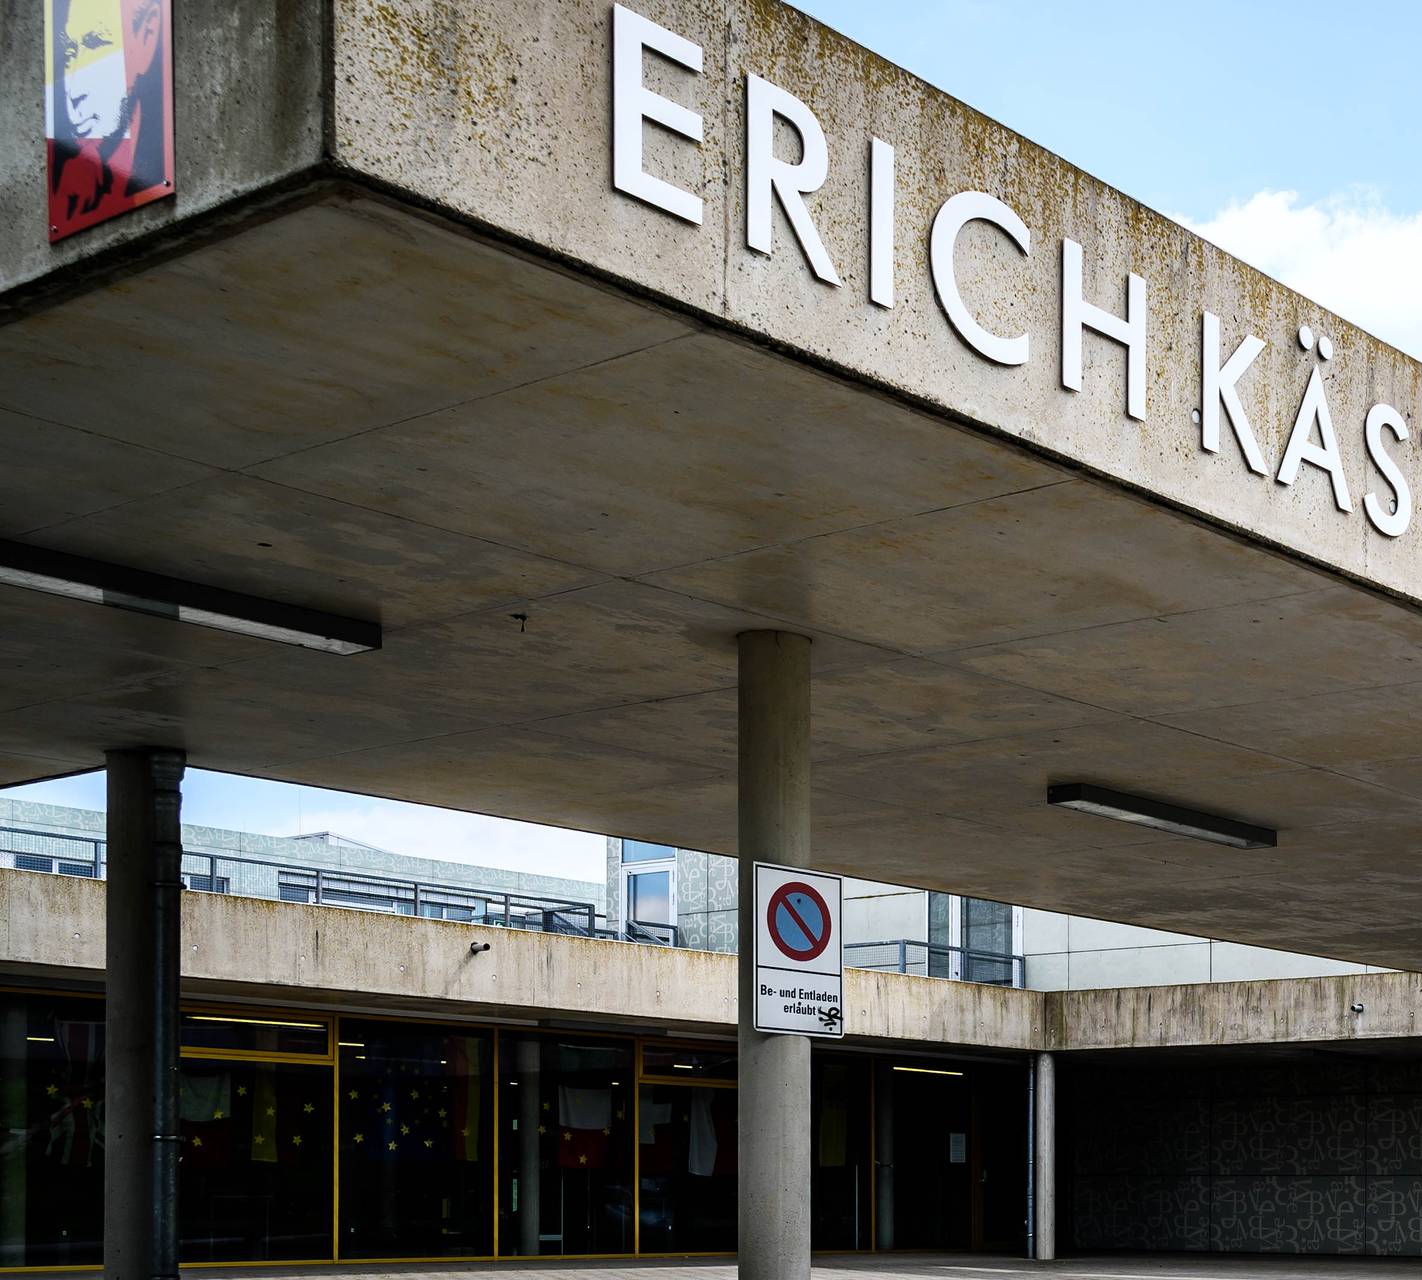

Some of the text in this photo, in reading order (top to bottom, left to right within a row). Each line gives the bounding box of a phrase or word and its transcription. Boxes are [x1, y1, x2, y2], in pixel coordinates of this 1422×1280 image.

[613, 2, 1147, 422] ERICH
[760, 984, 838, 1002] Be- und Entladen
[783, 1003, 816, 1016] erlaubt
